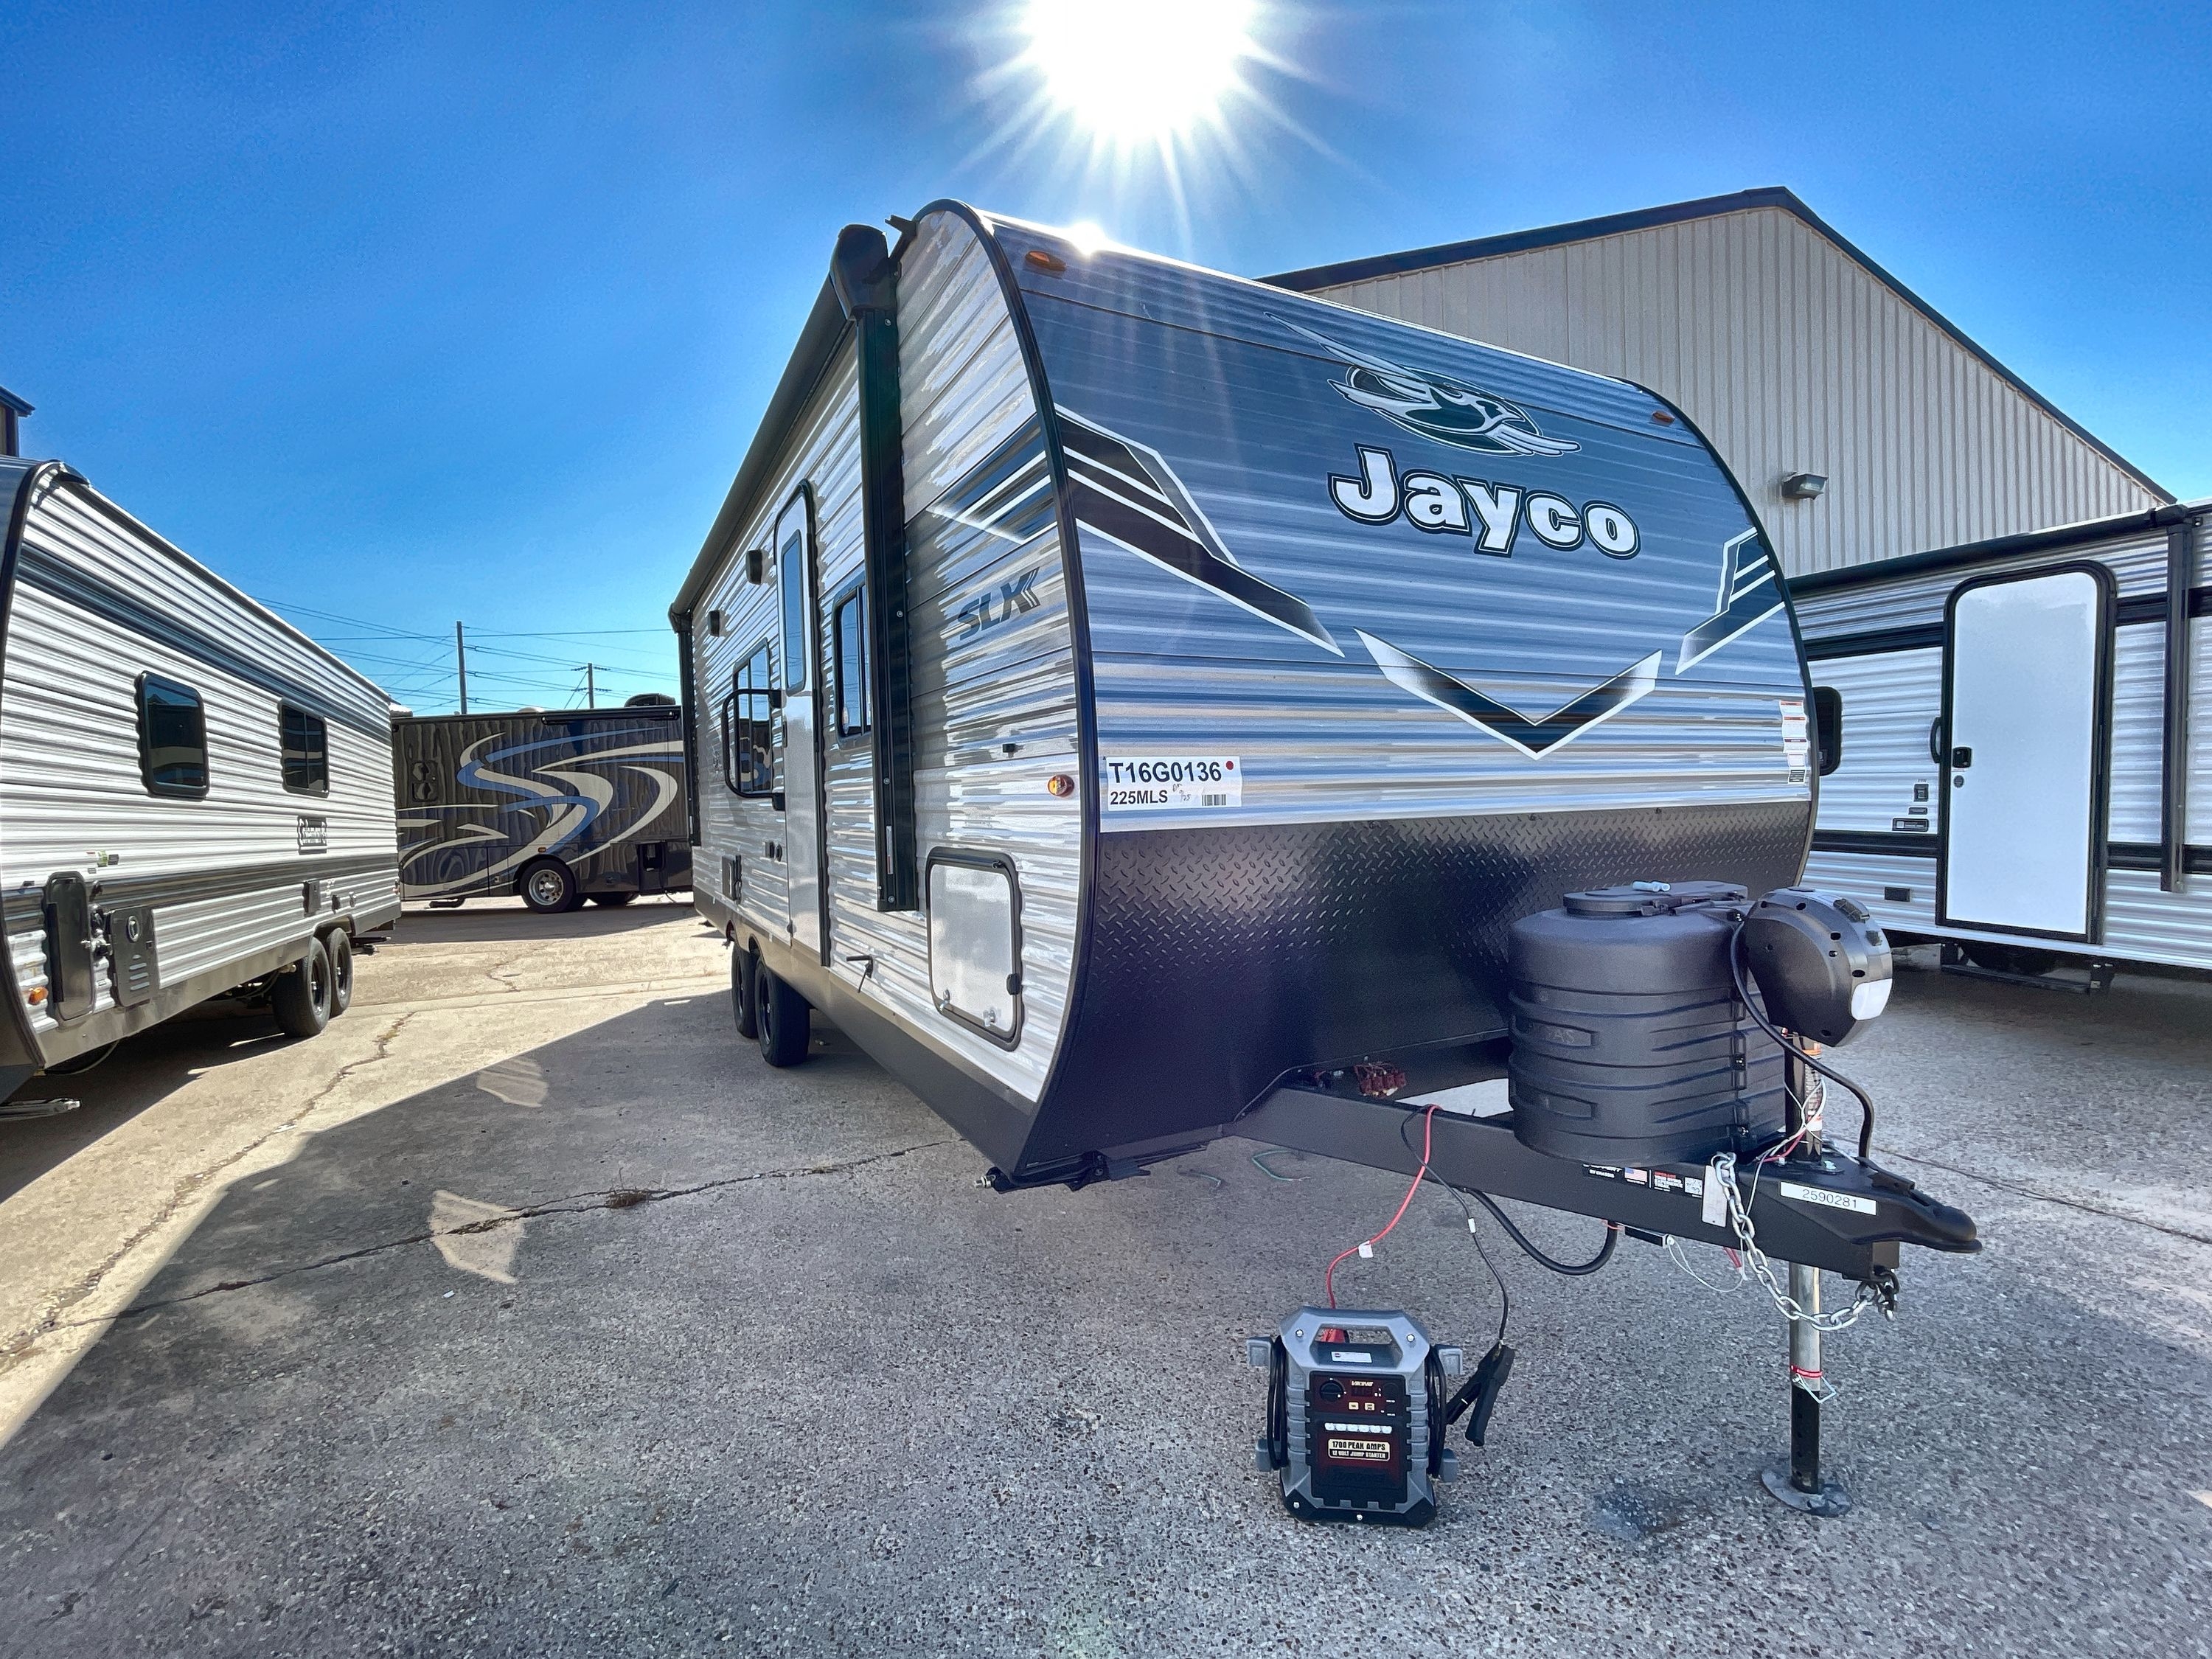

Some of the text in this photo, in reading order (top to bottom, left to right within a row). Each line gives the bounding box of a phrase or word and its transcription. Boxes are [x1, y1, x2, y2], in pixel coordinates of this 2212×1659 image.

[1327, 443, 1641, 559] Jayco
[1108, 761, 1222, 784] T16G0136
[1110, 789, 1169, 805] 225MLS
[1802, 1189, 1857, 1208] 2590281
[1332, 1441, 1347, 1449] 1700
[1348, 1441, 1364, 1450] PEAK
